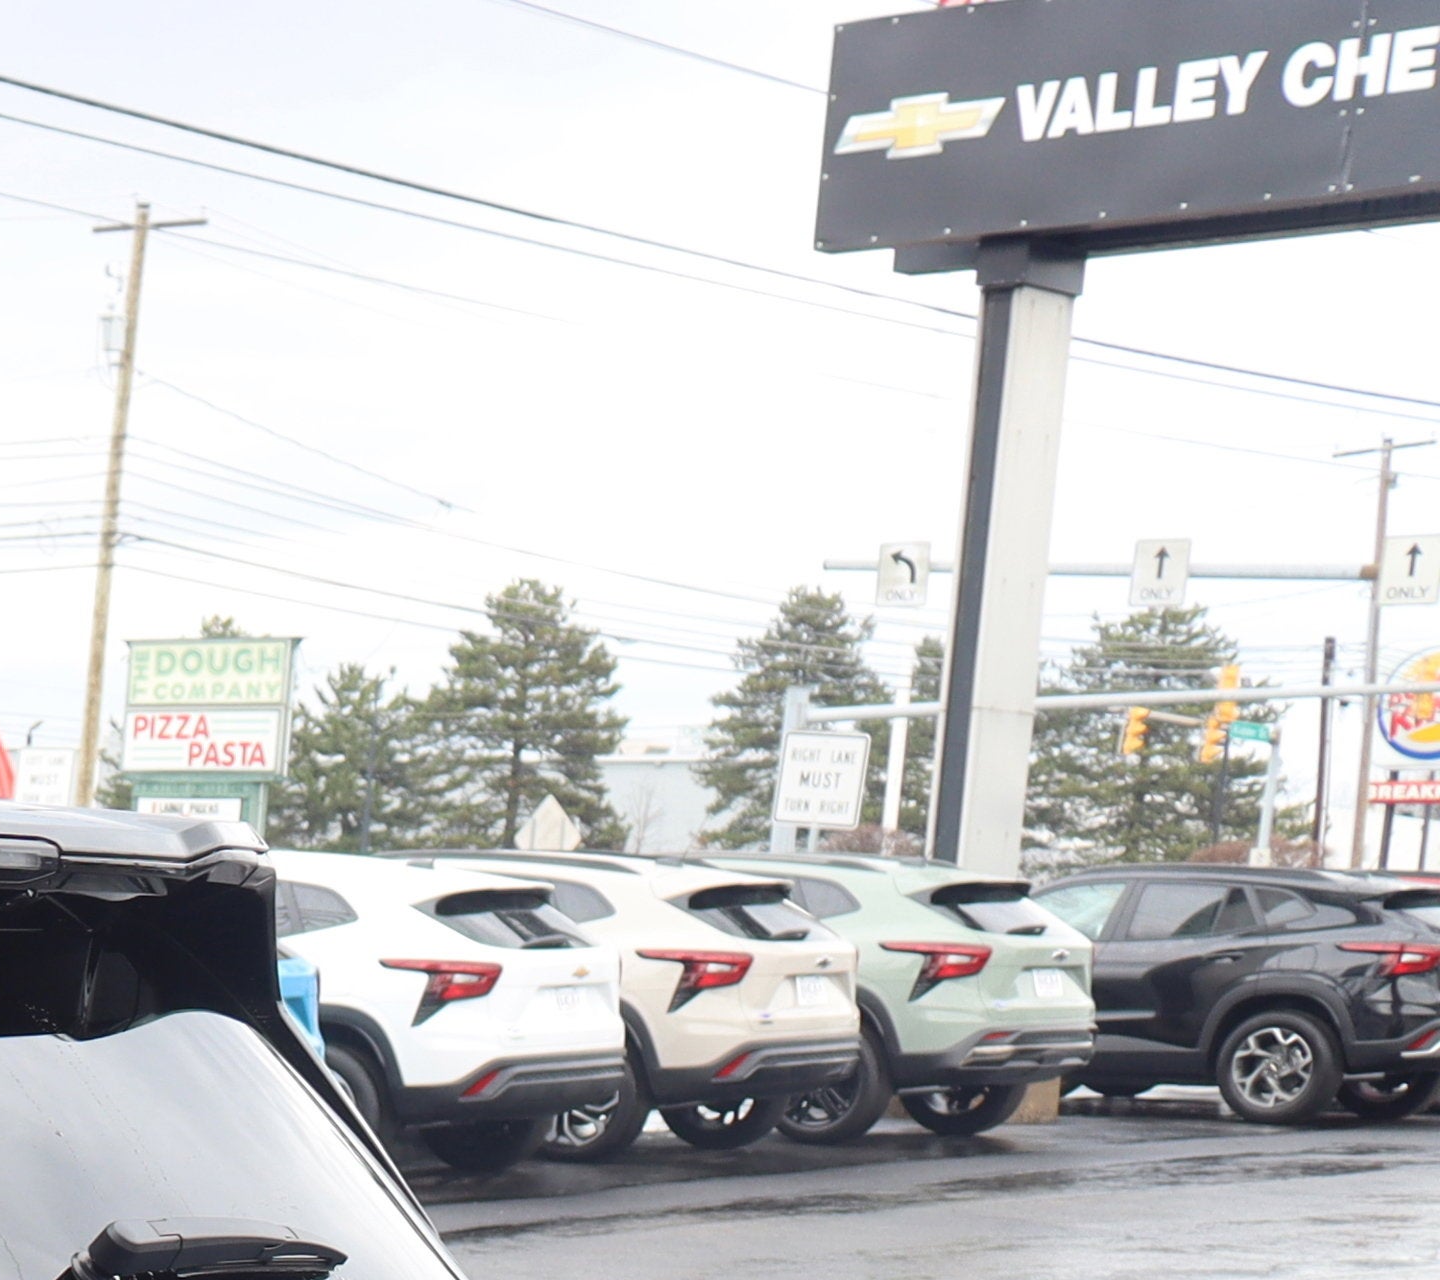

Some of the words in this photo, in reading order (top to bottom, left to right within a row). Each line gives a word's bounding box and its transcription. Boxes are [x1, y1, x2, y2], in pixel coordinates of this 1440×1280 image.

[1016, 50, 1268, 142] VALLEY
[1386, 585, 1431, 600] ONLY
[156, 647, 280, 677] DOUGH
[133, 650, 150, 698] THE
[154, 681, 281, 700] COMPANY
[133, 713, 210, 740] PIZZA
[188, 741, 266, 767] PASTA
[791, 747, 821, 762] RIGHT
[831, 749, 857, 765] LANE
[799, 770, 842, 789] MUST
[784, 796, 811, 812] TURN
[819, 799, 850, 815] RIGHT
